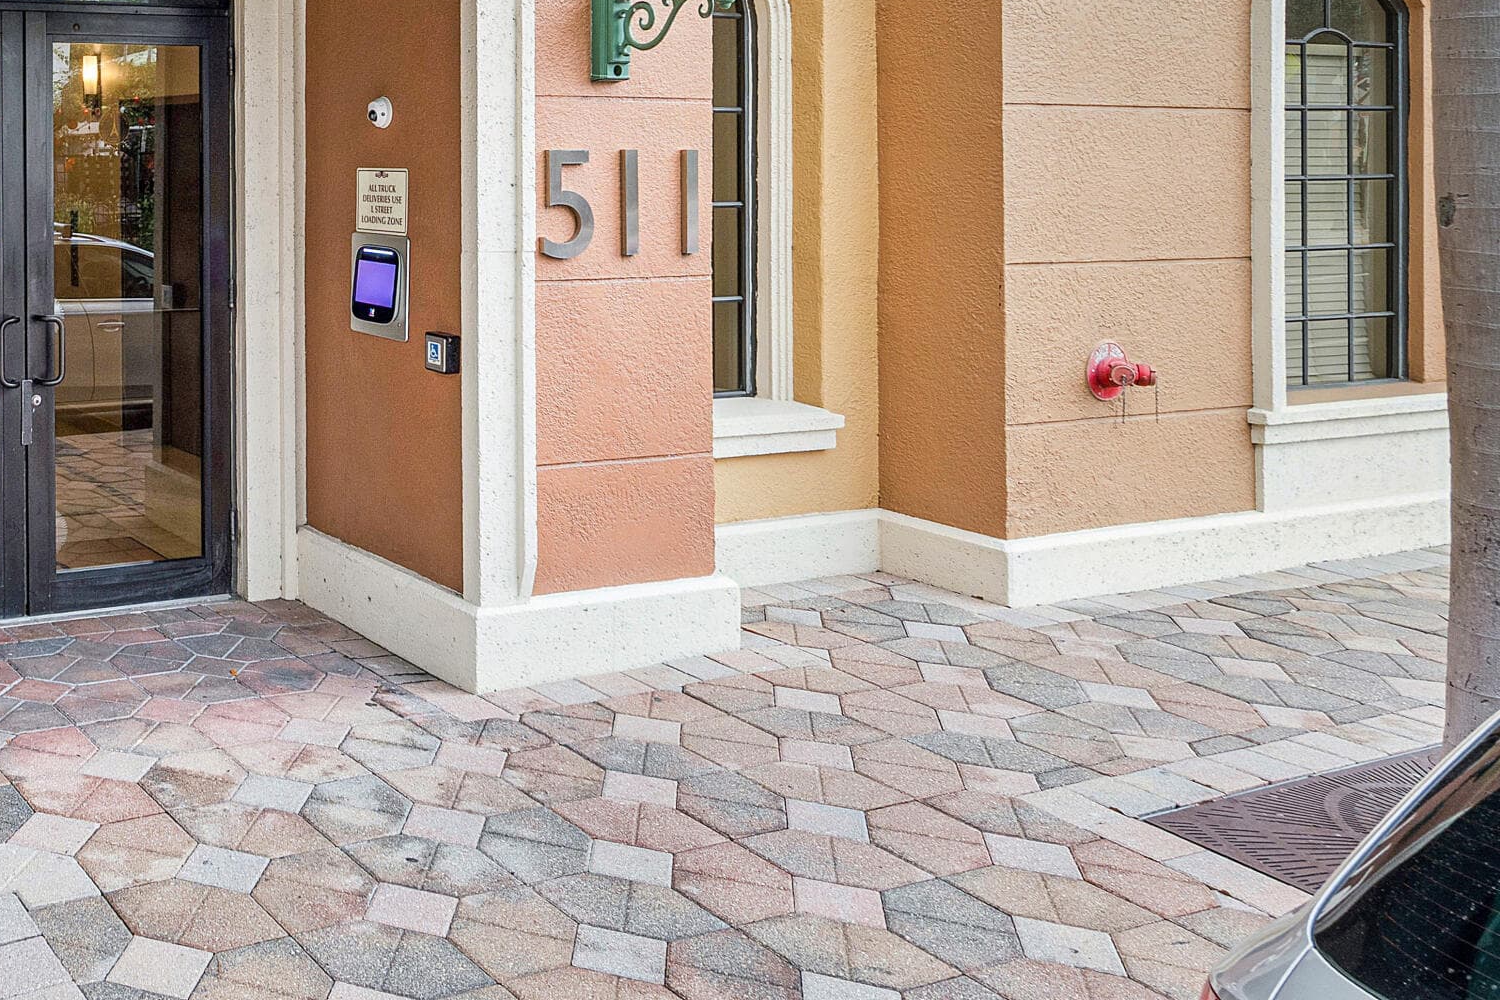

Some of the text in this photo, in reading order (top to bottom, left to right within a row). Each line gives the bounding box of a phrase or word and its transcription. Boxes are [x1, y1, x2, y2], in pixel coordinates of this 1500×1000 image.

[368, 184, 396, 193] ALL TRUCK
[362, 194, 402, 204] DELIVERIES USE
[375, 205, 393, 214] STREET
[538, 149, 699, 260] 511
[361, 215, 403, 226] LOADING ZONE
